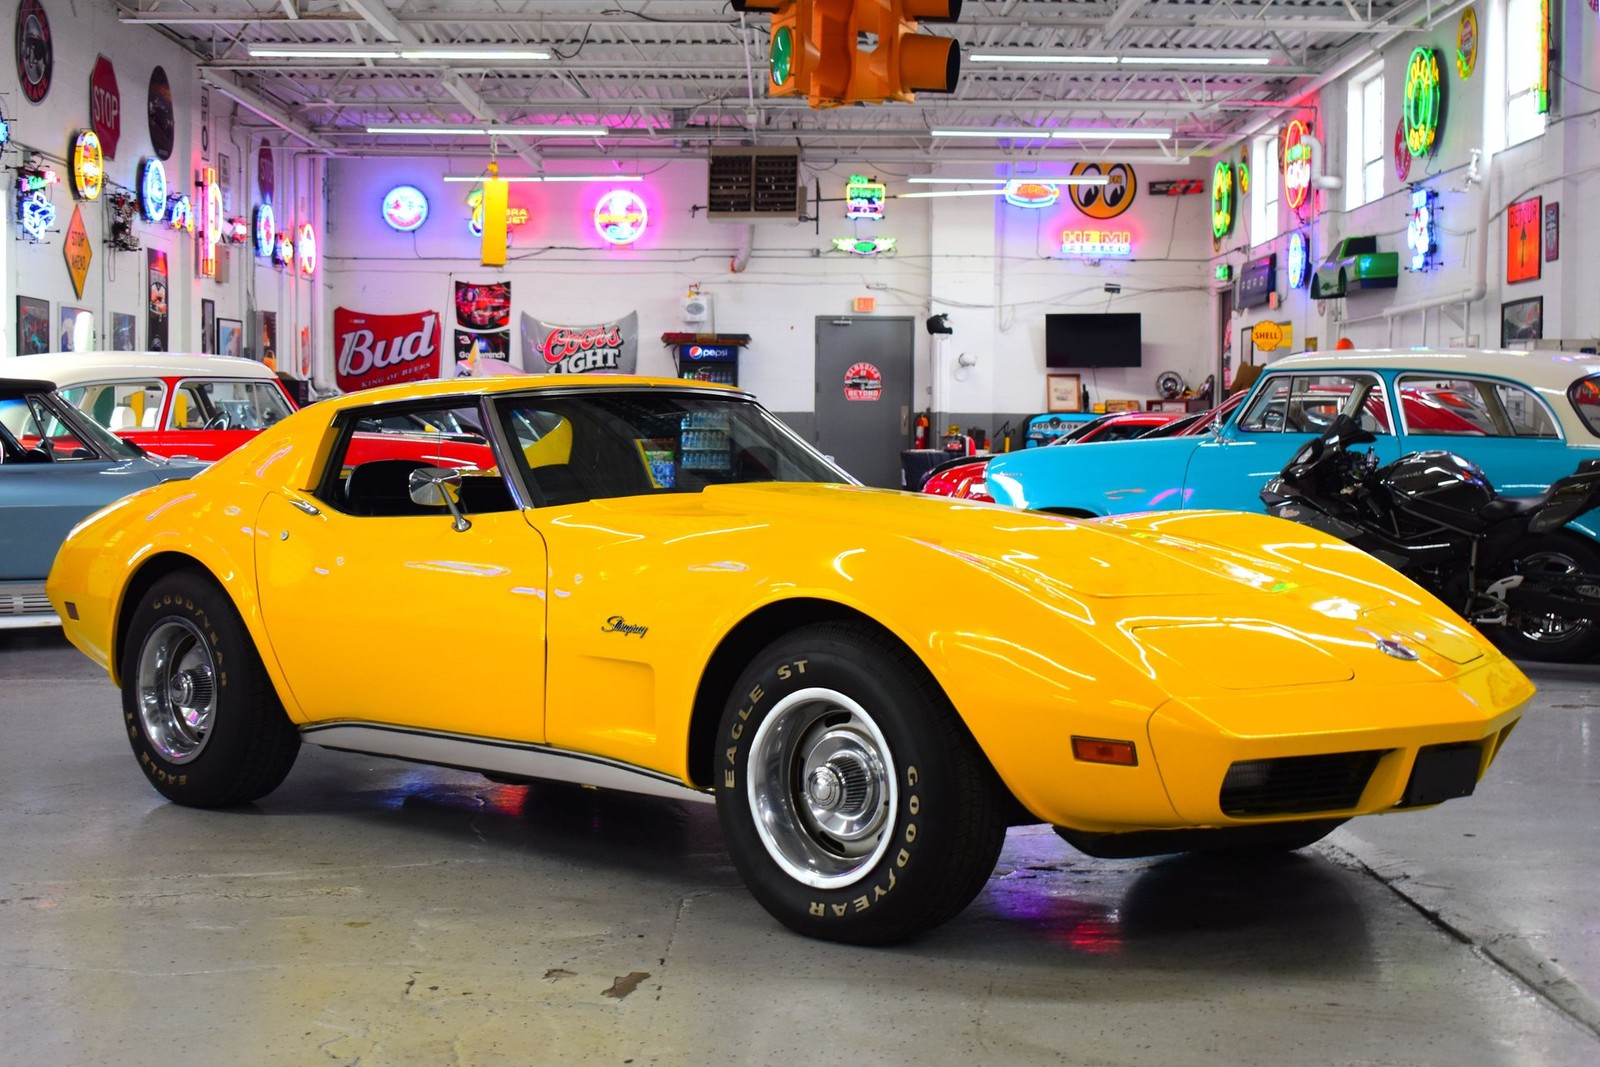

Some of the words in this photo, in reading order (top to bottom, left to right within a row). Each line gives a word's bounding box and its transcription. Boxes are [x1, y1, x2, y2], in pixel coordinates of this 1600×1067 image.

[93, 85, 118, 130] STOP
[505, 208, 528, 216] BRA
[1510, 203, 1537, 228] DETOUR
[71, 230, 85, 247] STOP
[1063, 230, 1130, 244] HEMI
[338, 314, 435, 377] Bud
[459, 335, 471, 344] 3
[537, 324, 623, 364] Coors
[1255, 332, 1278, 340] SHELL
[703, 348, 728, 358] pepsi
[361, 377, 385, 388] KING
[387, 372, 399, 382] OF
[402, 362, 432, 377] BEERS
[725, 684, 765, 788] EAGLE
[777, 660, 808, 680] ST
[141, 752, 187, 785] EAGLE
[809, 766, 920, 917] GOODYEAR
